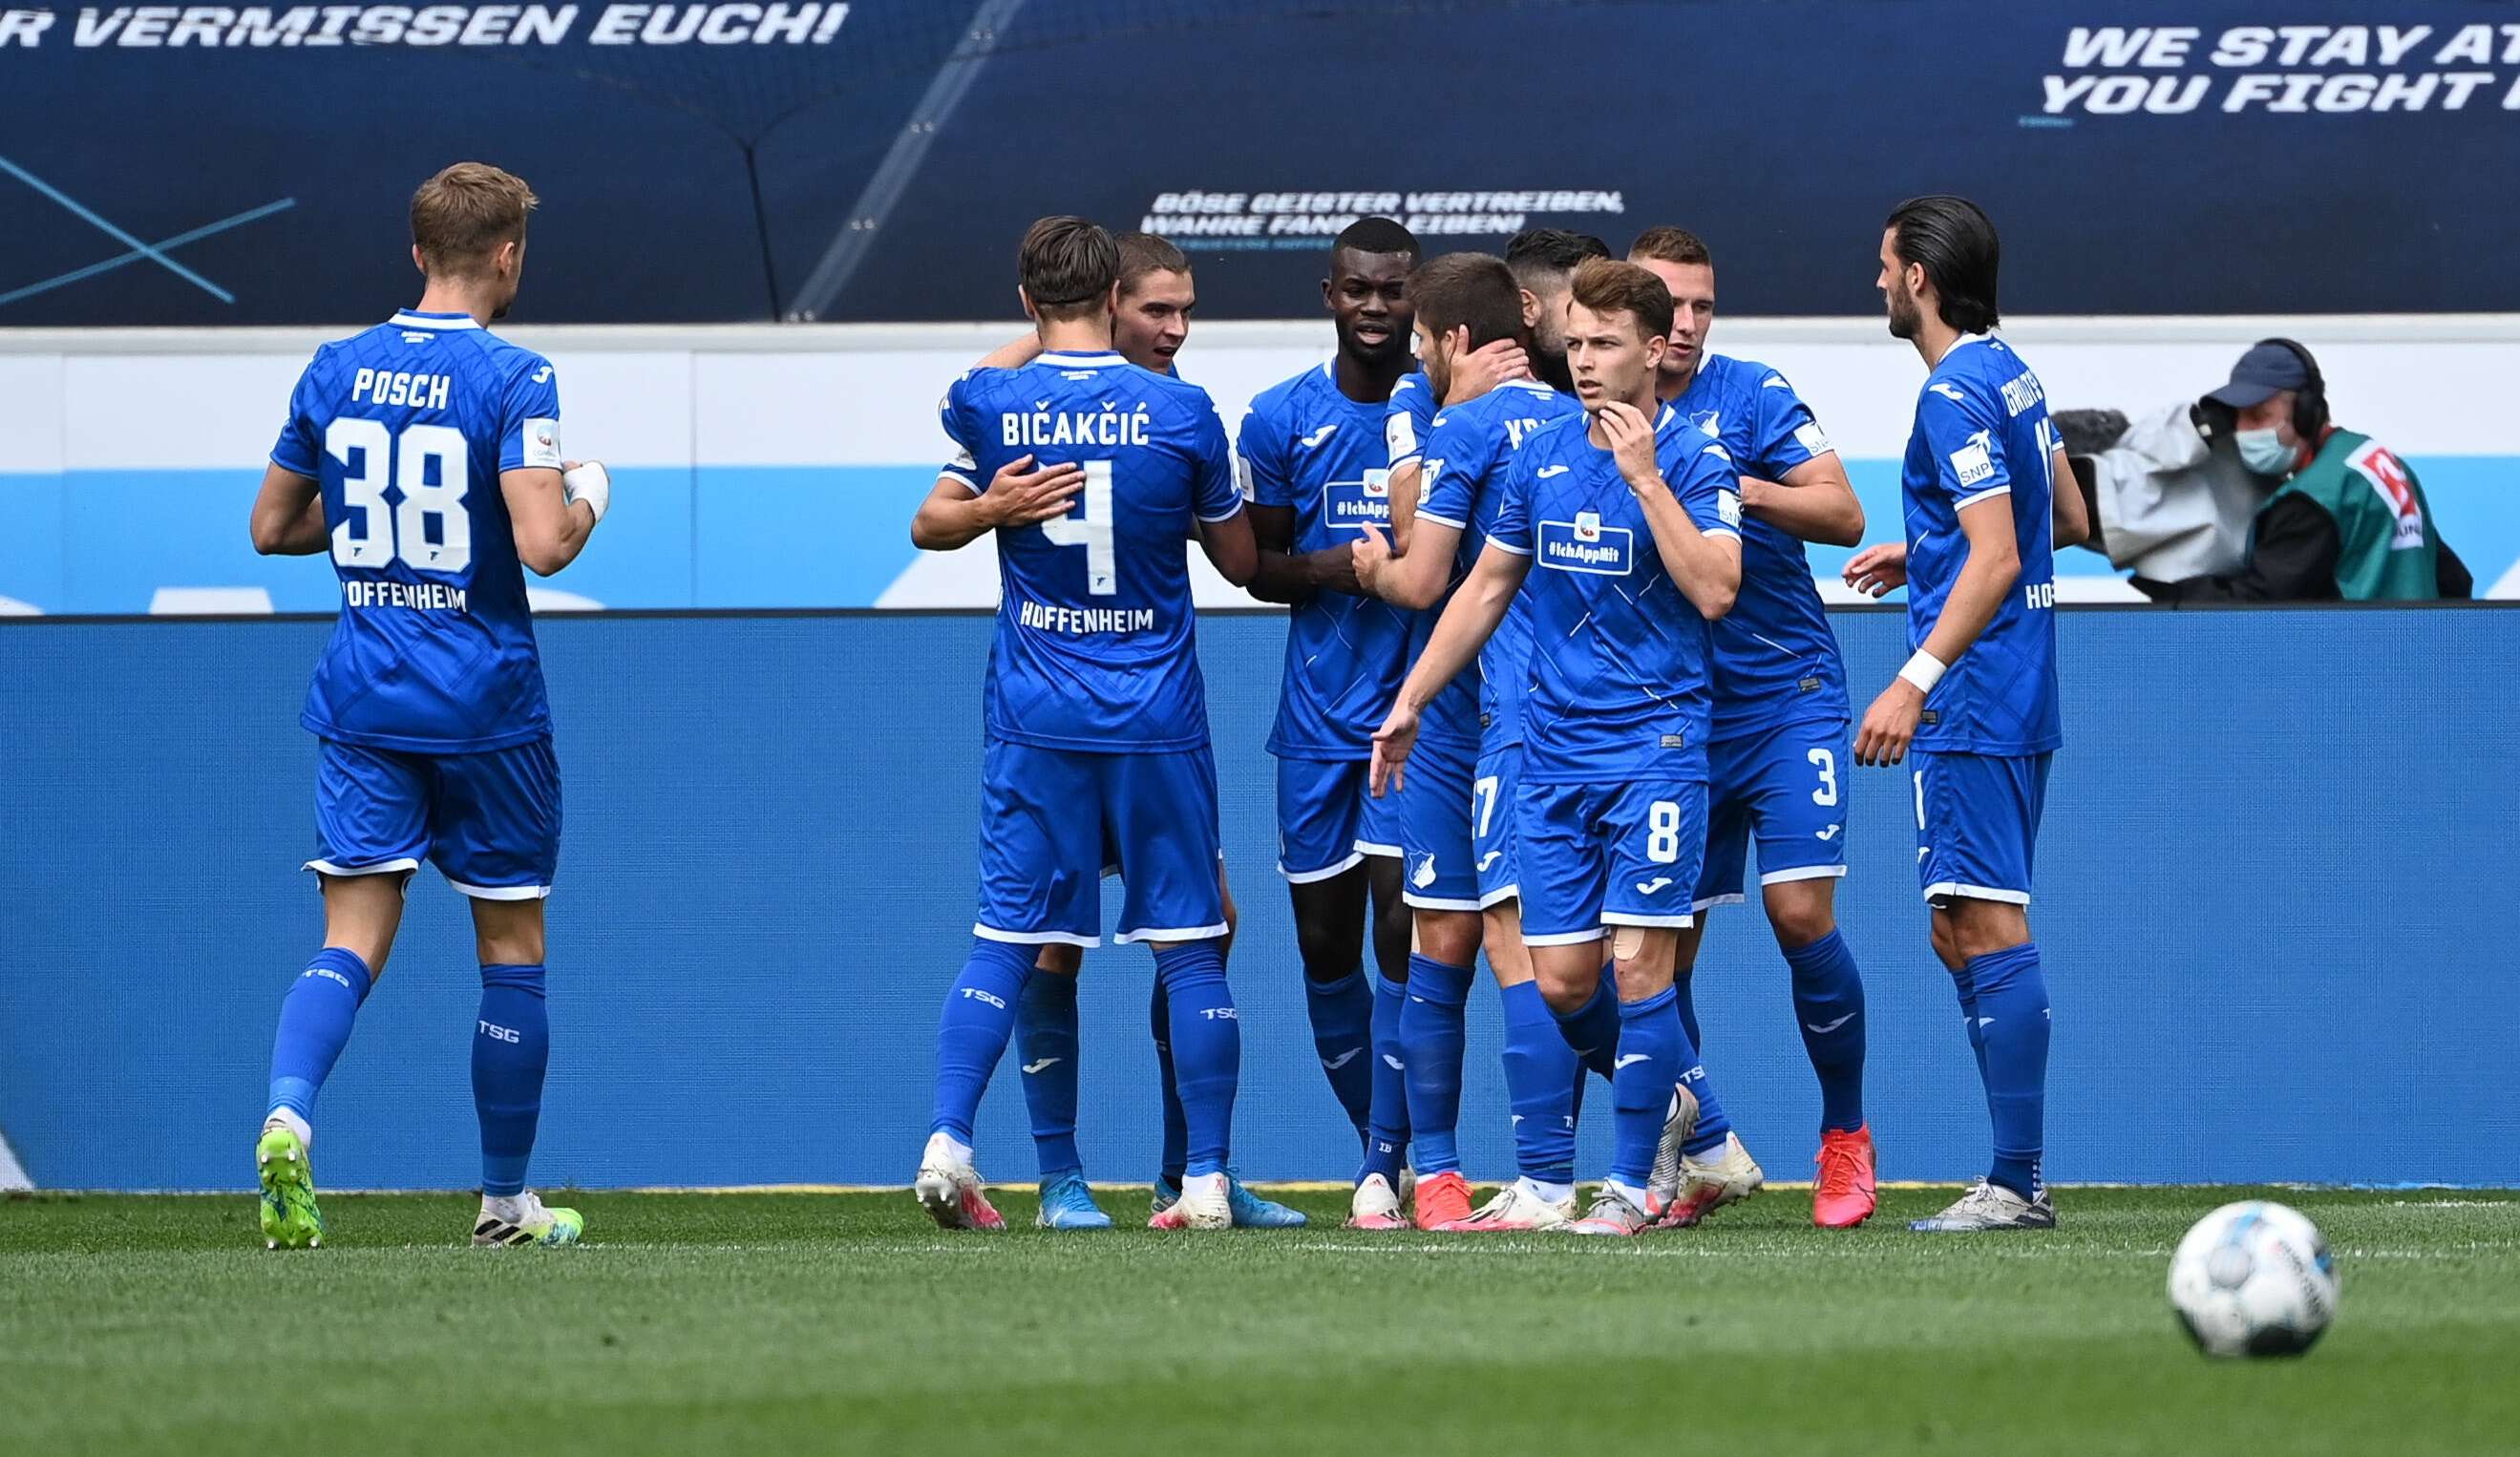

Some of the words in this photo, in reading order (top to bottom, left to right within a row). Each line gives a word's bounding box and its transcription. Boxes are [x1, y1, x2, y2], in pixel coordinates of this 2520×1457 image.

[74, 4, 576, 47] VERMISSEN
[589, 2, 849, 45] EUCH!
[2063, 26, 2200, 67] WE
[2210, 24, 2434, 66] STAY
[2043, 74, 2212, 114] YOU
[2221, 72, 2496, 112] FIGHT
[1152, 189, 1248, 214] BÖSE
[1250, 192, 1402, 213] GEISTER
[351, 368, 451, 411] POSCH
[1002, 400, 1151, 447] BIČAKČIĆ
[1959, 462, 1990, 483] SNP
[325, 415, 472, 574] 38
[1038, 458, 1117, 597] 4
[1548, 540, 1620, 565] #IchAppMit
[1019, 600, 1154, 635] HOFFENHEIM
[1807, 748, 1838, 807] 3
[1472, 775, 1498, 841] 7
[1646, 800, 1681, 864] 8
[961, 987, 1006, 1010] TSG
[1199, 1007, 1238, 1021] TSG
[478, 1020, 520, 1044] TSG
